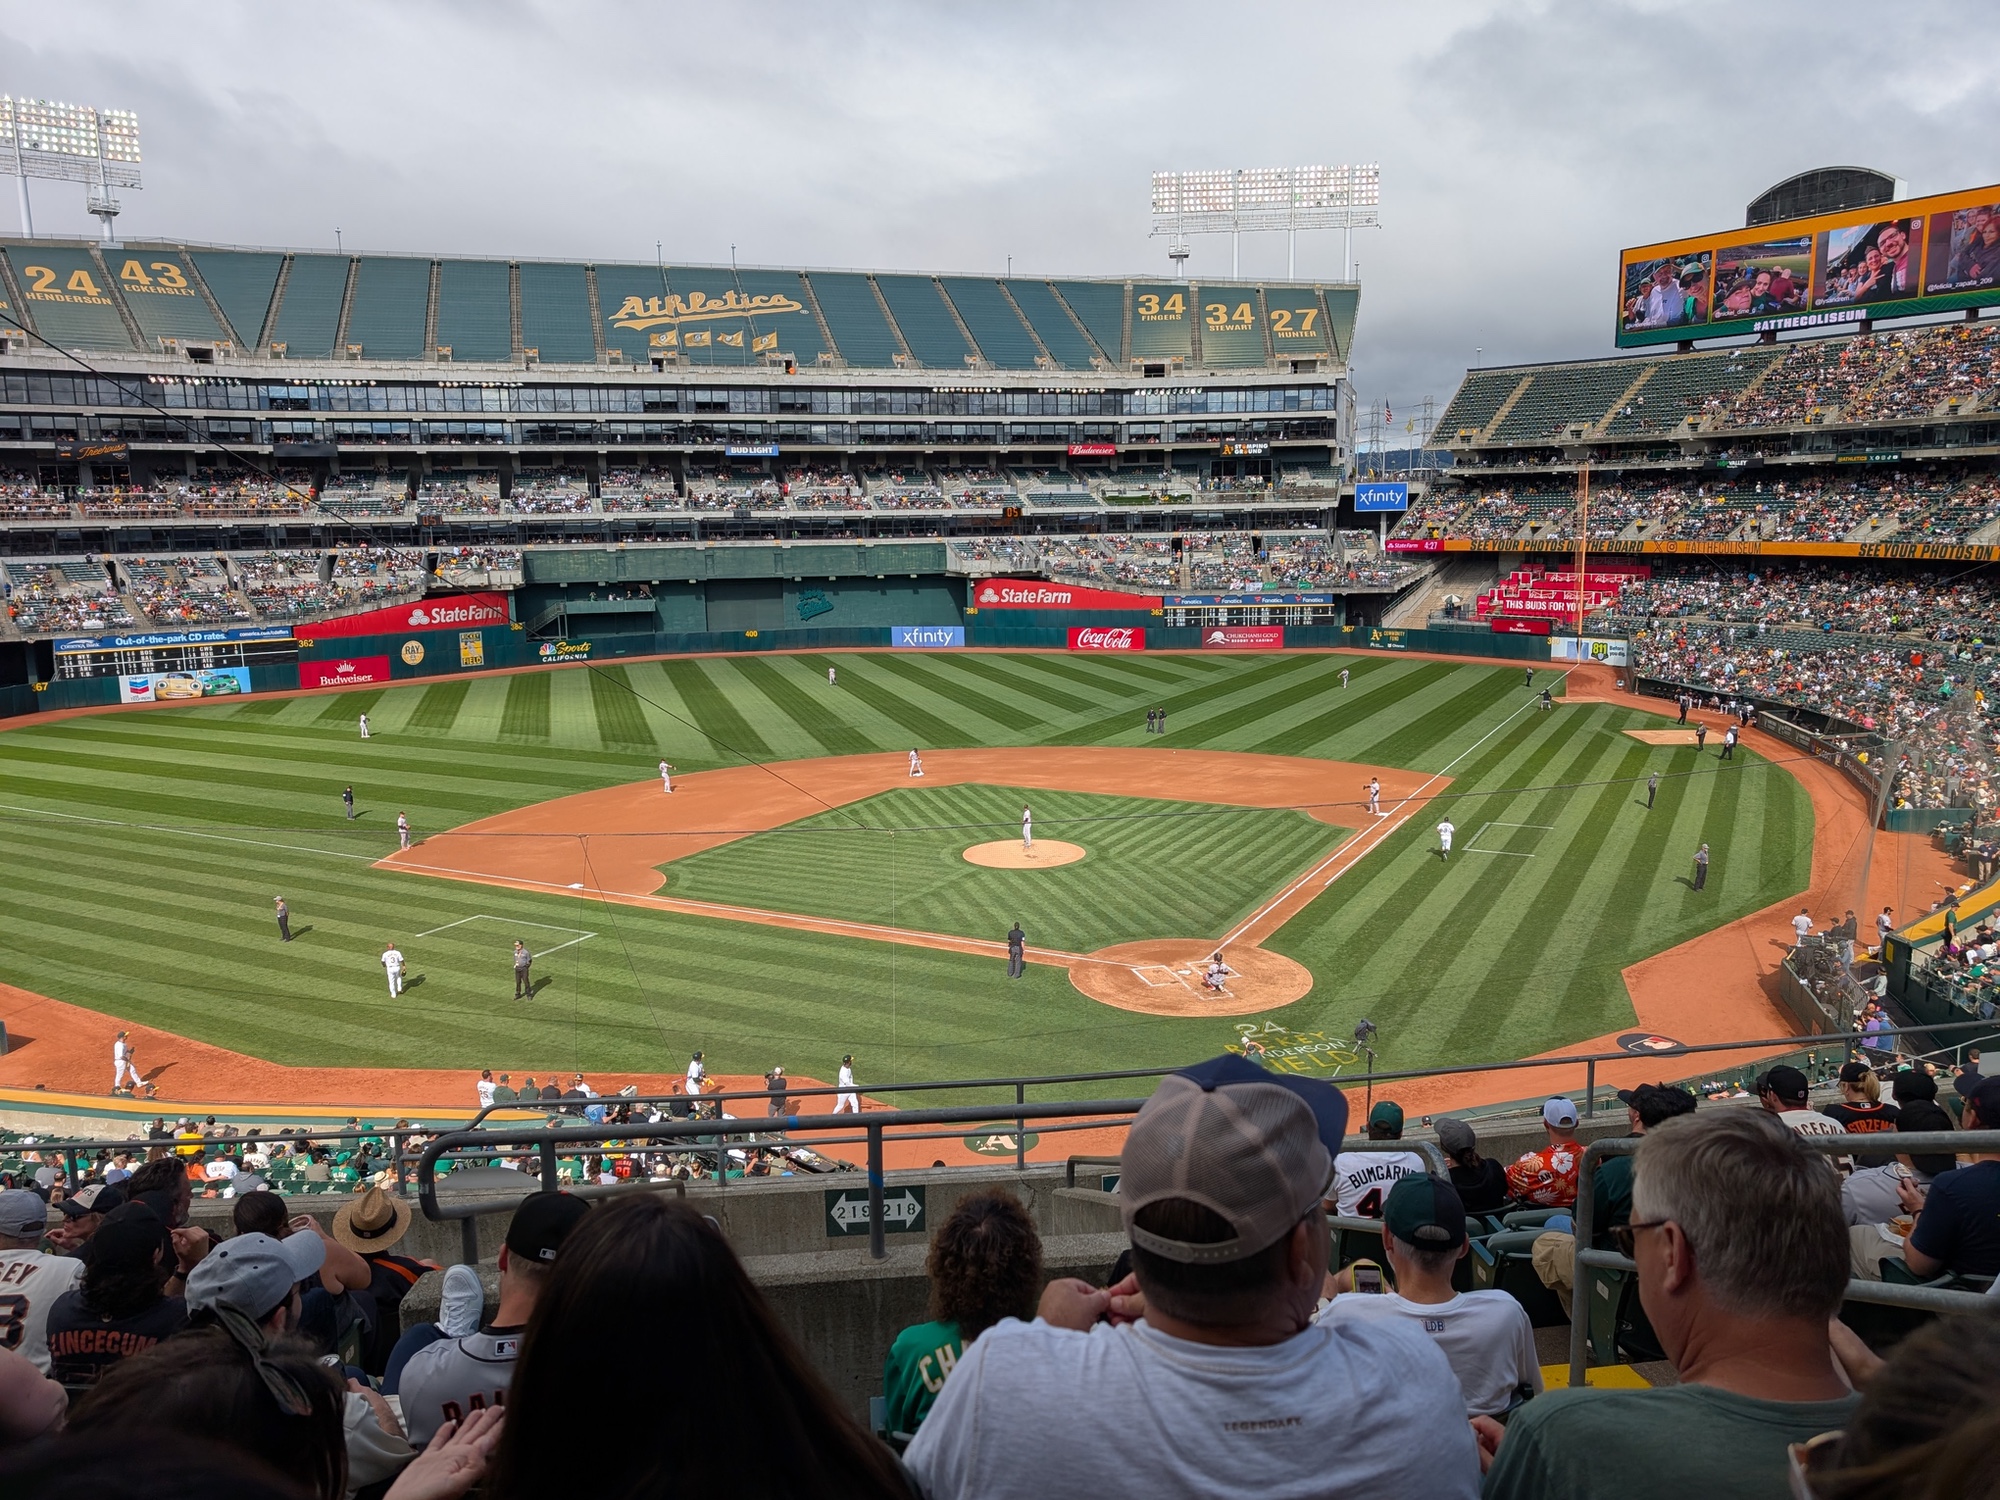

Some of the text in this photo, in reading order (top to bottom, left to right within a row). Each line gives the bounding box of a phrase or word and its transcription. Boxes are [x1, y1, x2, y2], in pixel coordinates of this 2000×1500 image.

[24, 265, 102, 296] 24
[120, 259, 188, 288] 43
[123, 283, 196, 297] ECKERSLEY
[1927, 276, 1993, 292] @felicia_zapata_209
[25, 292, 112, 306] HENDERSON
[1137, 293, 1187, 315] 34
[608, 289, 800, 327] Athletics
[1205, 302, 1255, 325] 34
[1141, 313, 1182, 321] FINGERS
[1270, 308, 1319, 332] 27
[1753, 308, 1867, 332] #ATTHECOLISEUM
[1209, 324, 1252, 332] STEWART
[77, 443, 127, 459] Treehouse
[730, 446, 773, 455] BUD LIGHT
[1069, 445, 1115, 455] Budweiser
[1359, 489, 1403, 505] xfinity
[1424, 542, 1438, 550] 4:27
[1470, 540, 1490, 551] SEE
[1491, 540, 1520, 551] YOUR
[1523, 540, 1563, 552] PHOTOS
[1586, 540, 1606, 552] THE
[1608, 540, 1644, 552] BOARD
[1685, 541, 1762, 555] #ATTHECOLISEUM
[1858, 543, 1993, 560] SEE YOUR PHOTOS ON
[1150, 608, 1163, 616] 362
[1506, 600, 1523, 609] THIS
[1525, 600, 1546, 610] BUDS
[1550, 601, 1565, 611] FOR
[745, 630, 758, 638] 400
[1341, 625, 1355, 633] 367
[115, 632, 227, 646] Out-of-the-park CD rates.
[298, 639, 314, 648] 362
[903, 628, 953, 646] xfinity
[1077, 628, 1134, 649] Coca-Cola
[404, 645, 420, 655] RAY
[556, 641, 591, 655] Sports
[1593, 642, 1607, 654] 811
[463, 657, 482, 665] FIELD
[32, 682, 49, 692] 367
[1234, 1020, 1291, 1038] 24
[1224, 1031, 1328, 1054] RCKEY
[557, 1167, 572, 1178] 44
[837, 1203, 916, 1219] 219 218
